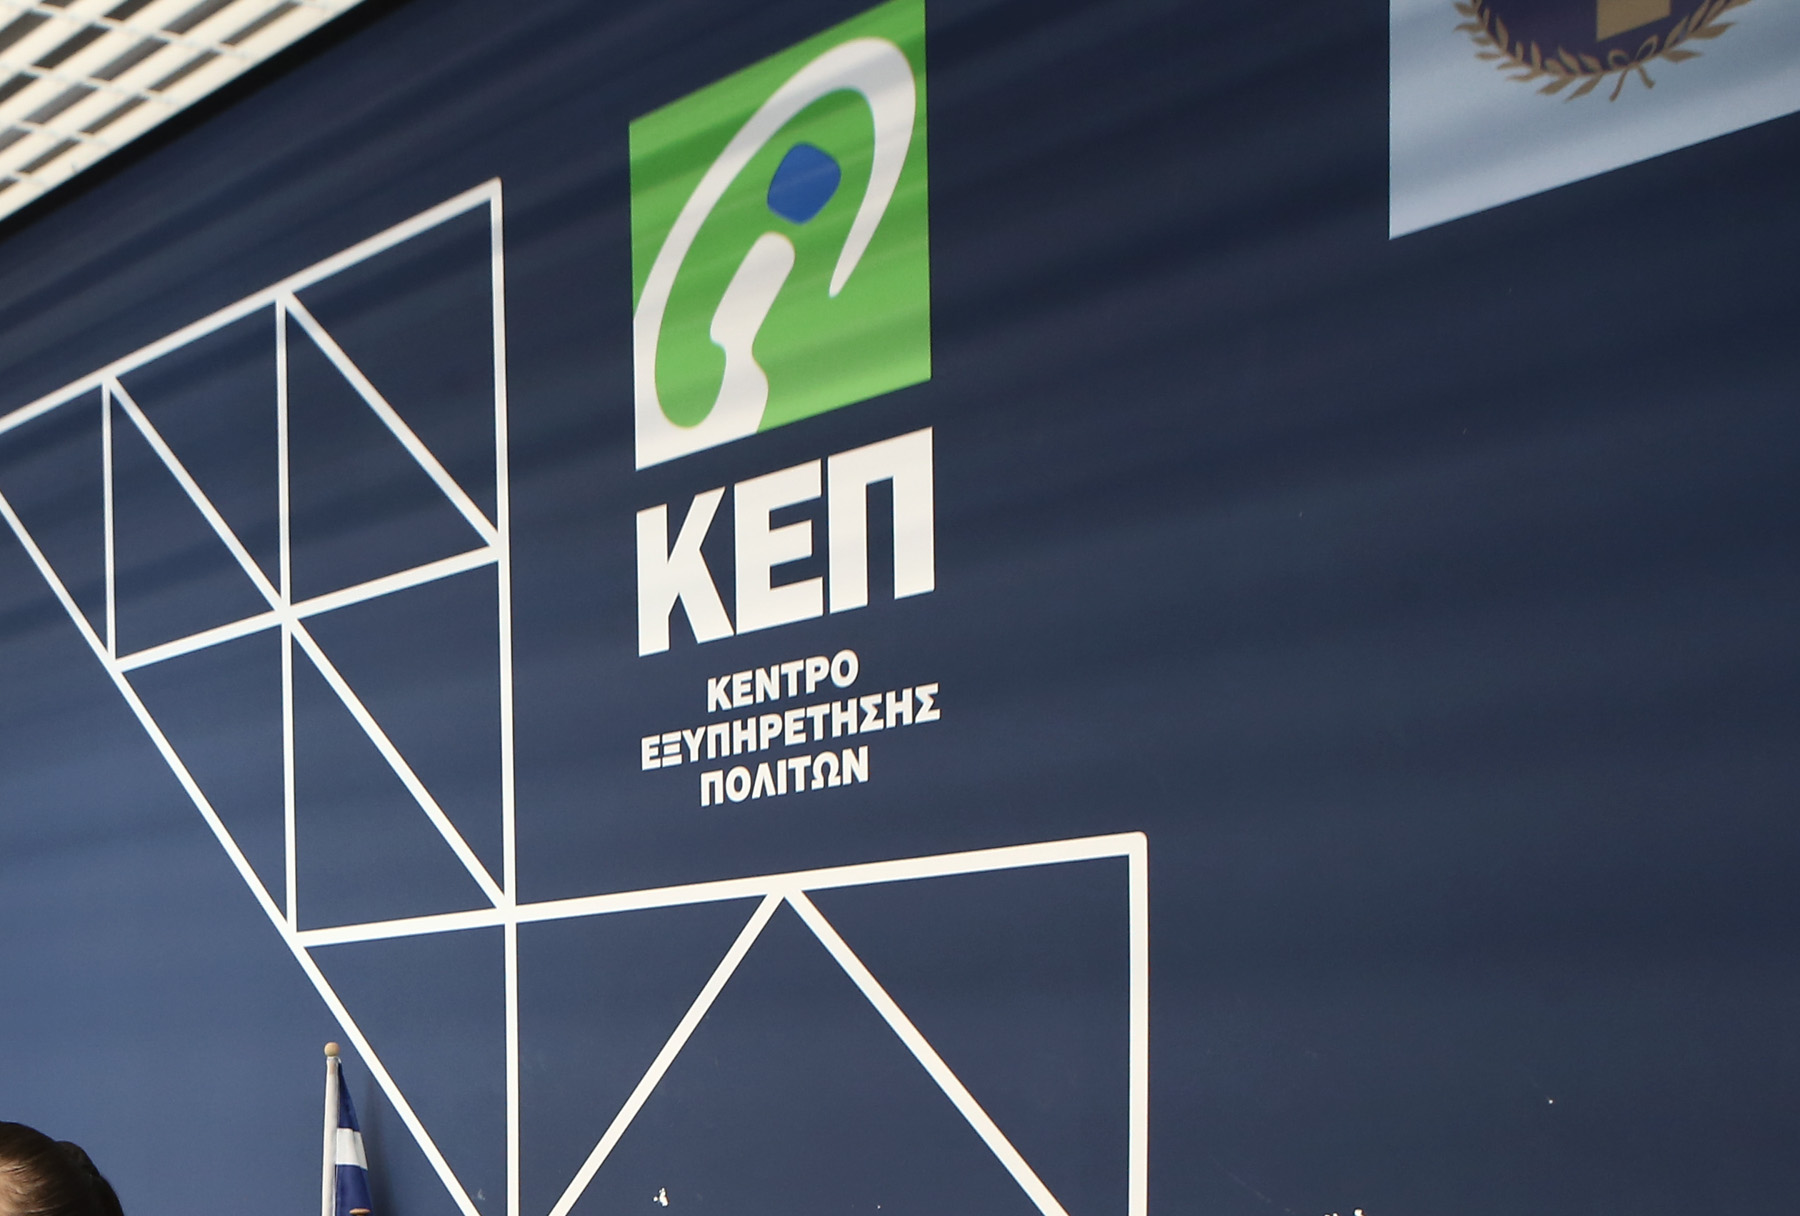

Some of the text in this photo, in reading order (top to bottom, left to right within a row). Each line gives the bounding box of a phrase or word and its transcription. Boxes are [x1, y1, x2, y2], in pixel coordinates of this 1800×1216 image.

[636, 426, 935, 657] ΚΕΠ
[707, 649, 859, 712] ΚΕΝΤΡΟ
[641, 683, 941, 771] ΕΞΥΠΗΡΕΤΗΣΗΣ
[700, 745, 869, 807] ΠΟΛΙΤΩΝ
